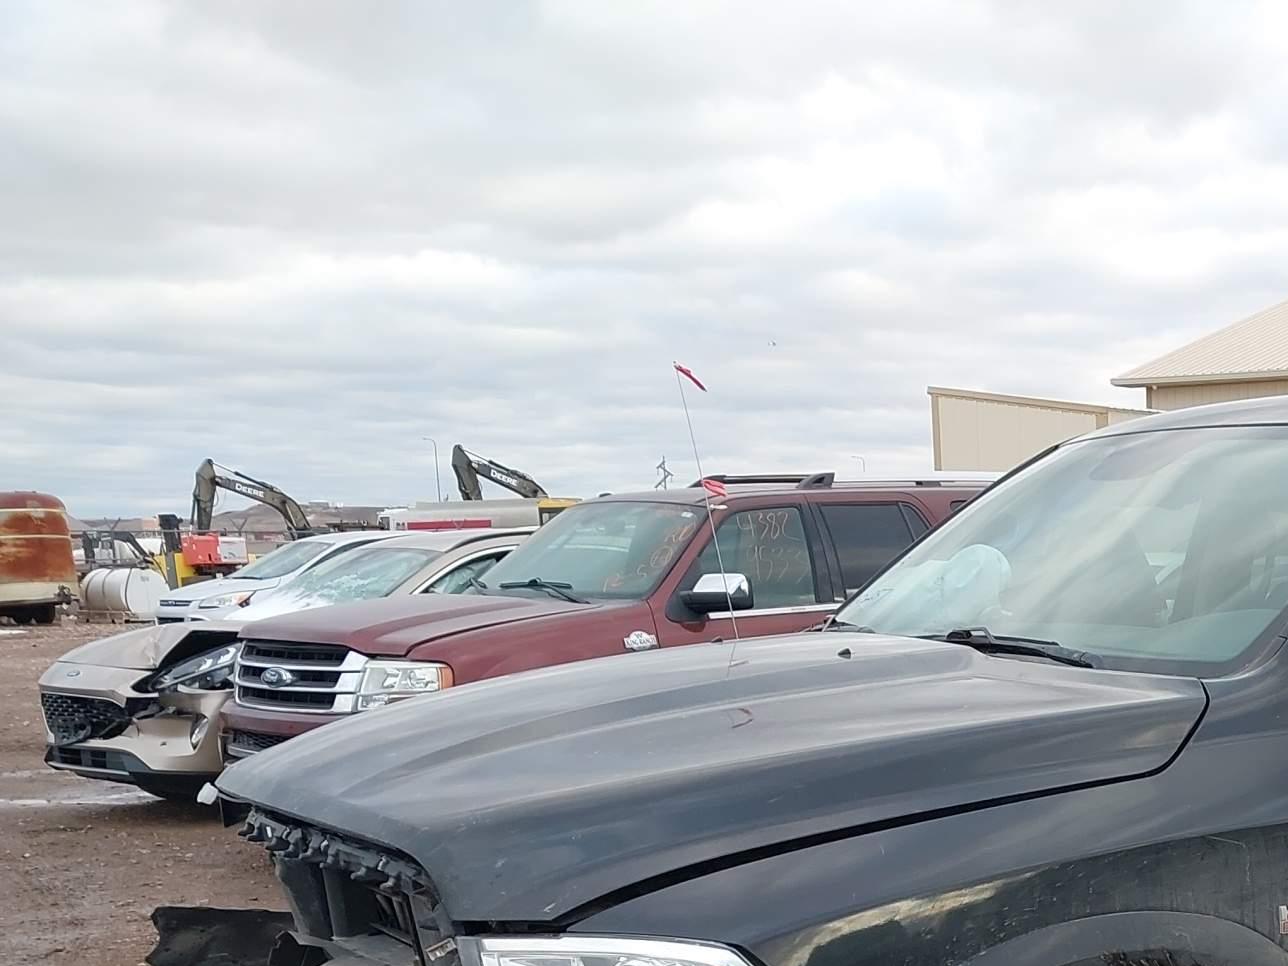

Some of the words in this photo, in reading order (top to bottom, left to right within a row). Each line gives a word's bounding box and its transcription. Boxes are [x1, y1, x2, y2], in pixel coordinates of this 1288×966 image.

[490, 468, 518, 487] DEERE
[235, 482, 265, 498] DEERE
[736, 511, 801, 541] 4382
